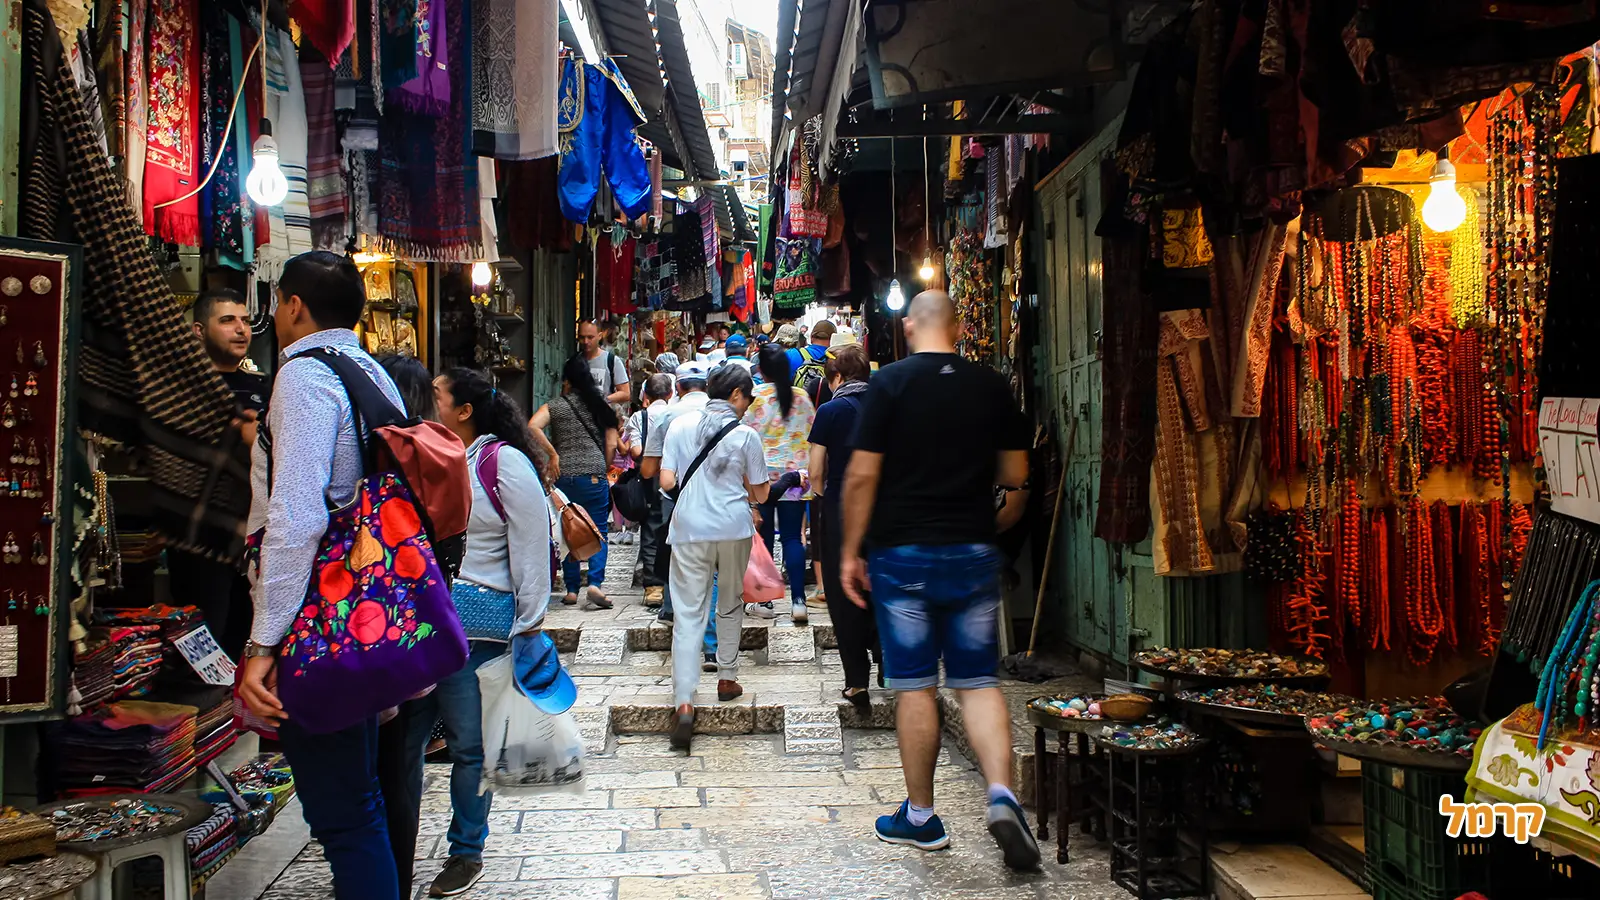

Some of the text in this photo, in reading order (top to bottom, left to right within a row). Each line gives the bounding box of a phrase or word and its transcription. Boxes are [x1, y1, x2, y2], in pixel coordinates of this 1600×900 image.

[1543, 400, 1557, 426] The
[177, 629, 219, 664] CASHMERE
[203, 663, 226, 683] FOR
